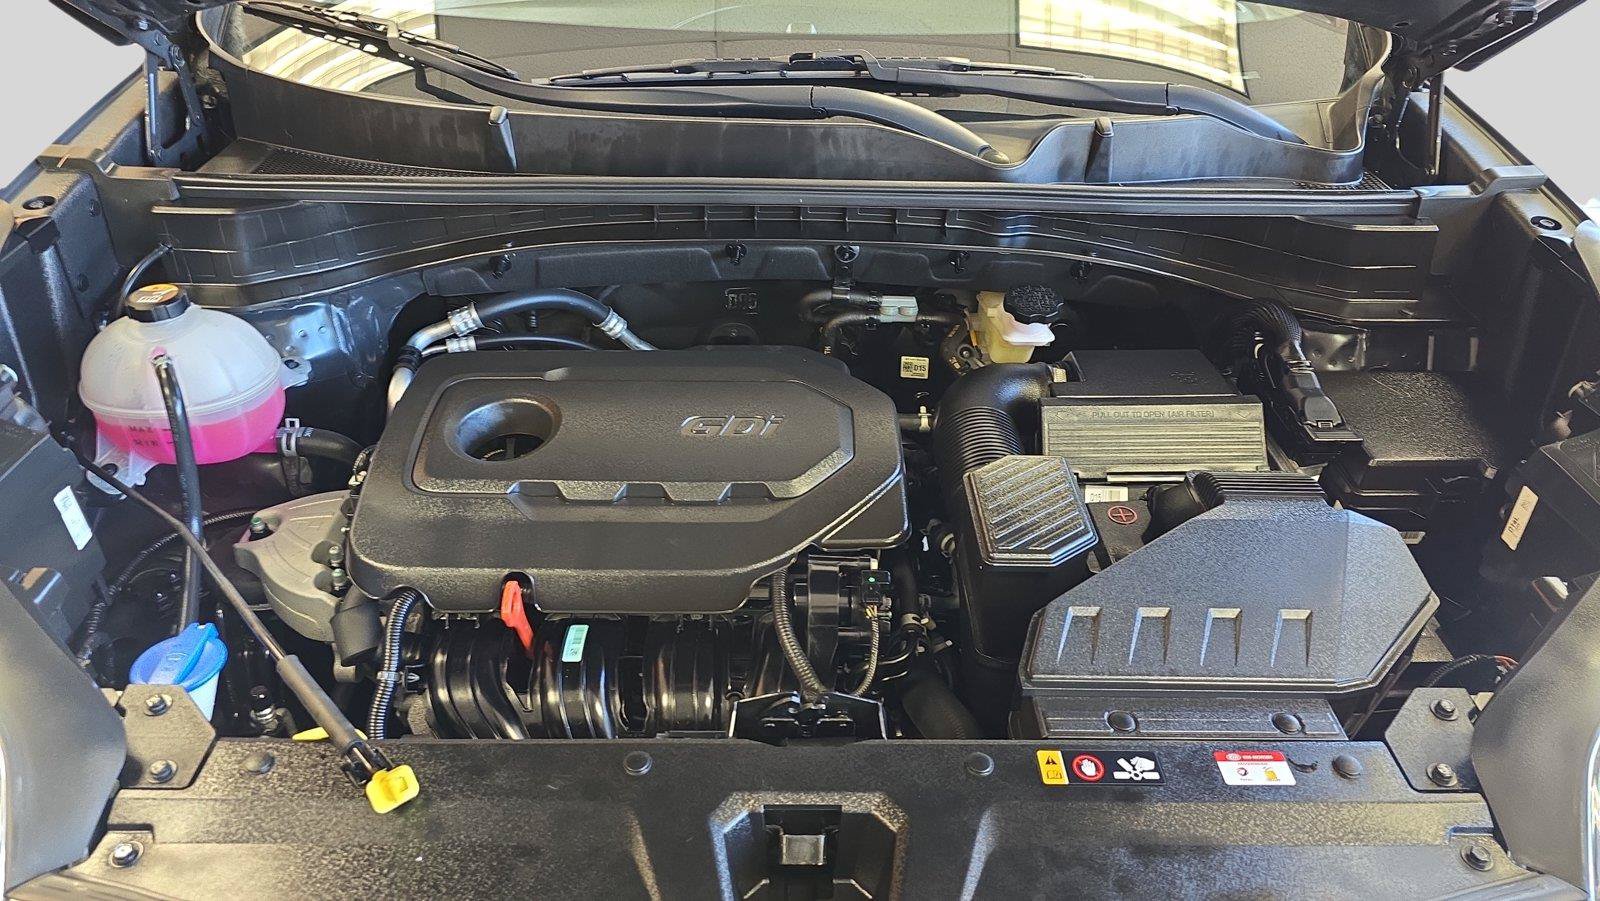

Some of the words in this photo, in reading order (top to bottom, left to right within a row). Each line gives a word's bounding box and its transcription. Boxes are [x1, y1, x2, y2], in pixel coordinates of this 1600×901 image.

[1092, 411, 1110, 419] PULL
[1114, 411, 1129, 419] OUT
[1144, 410, 1164, 418] OPEN
